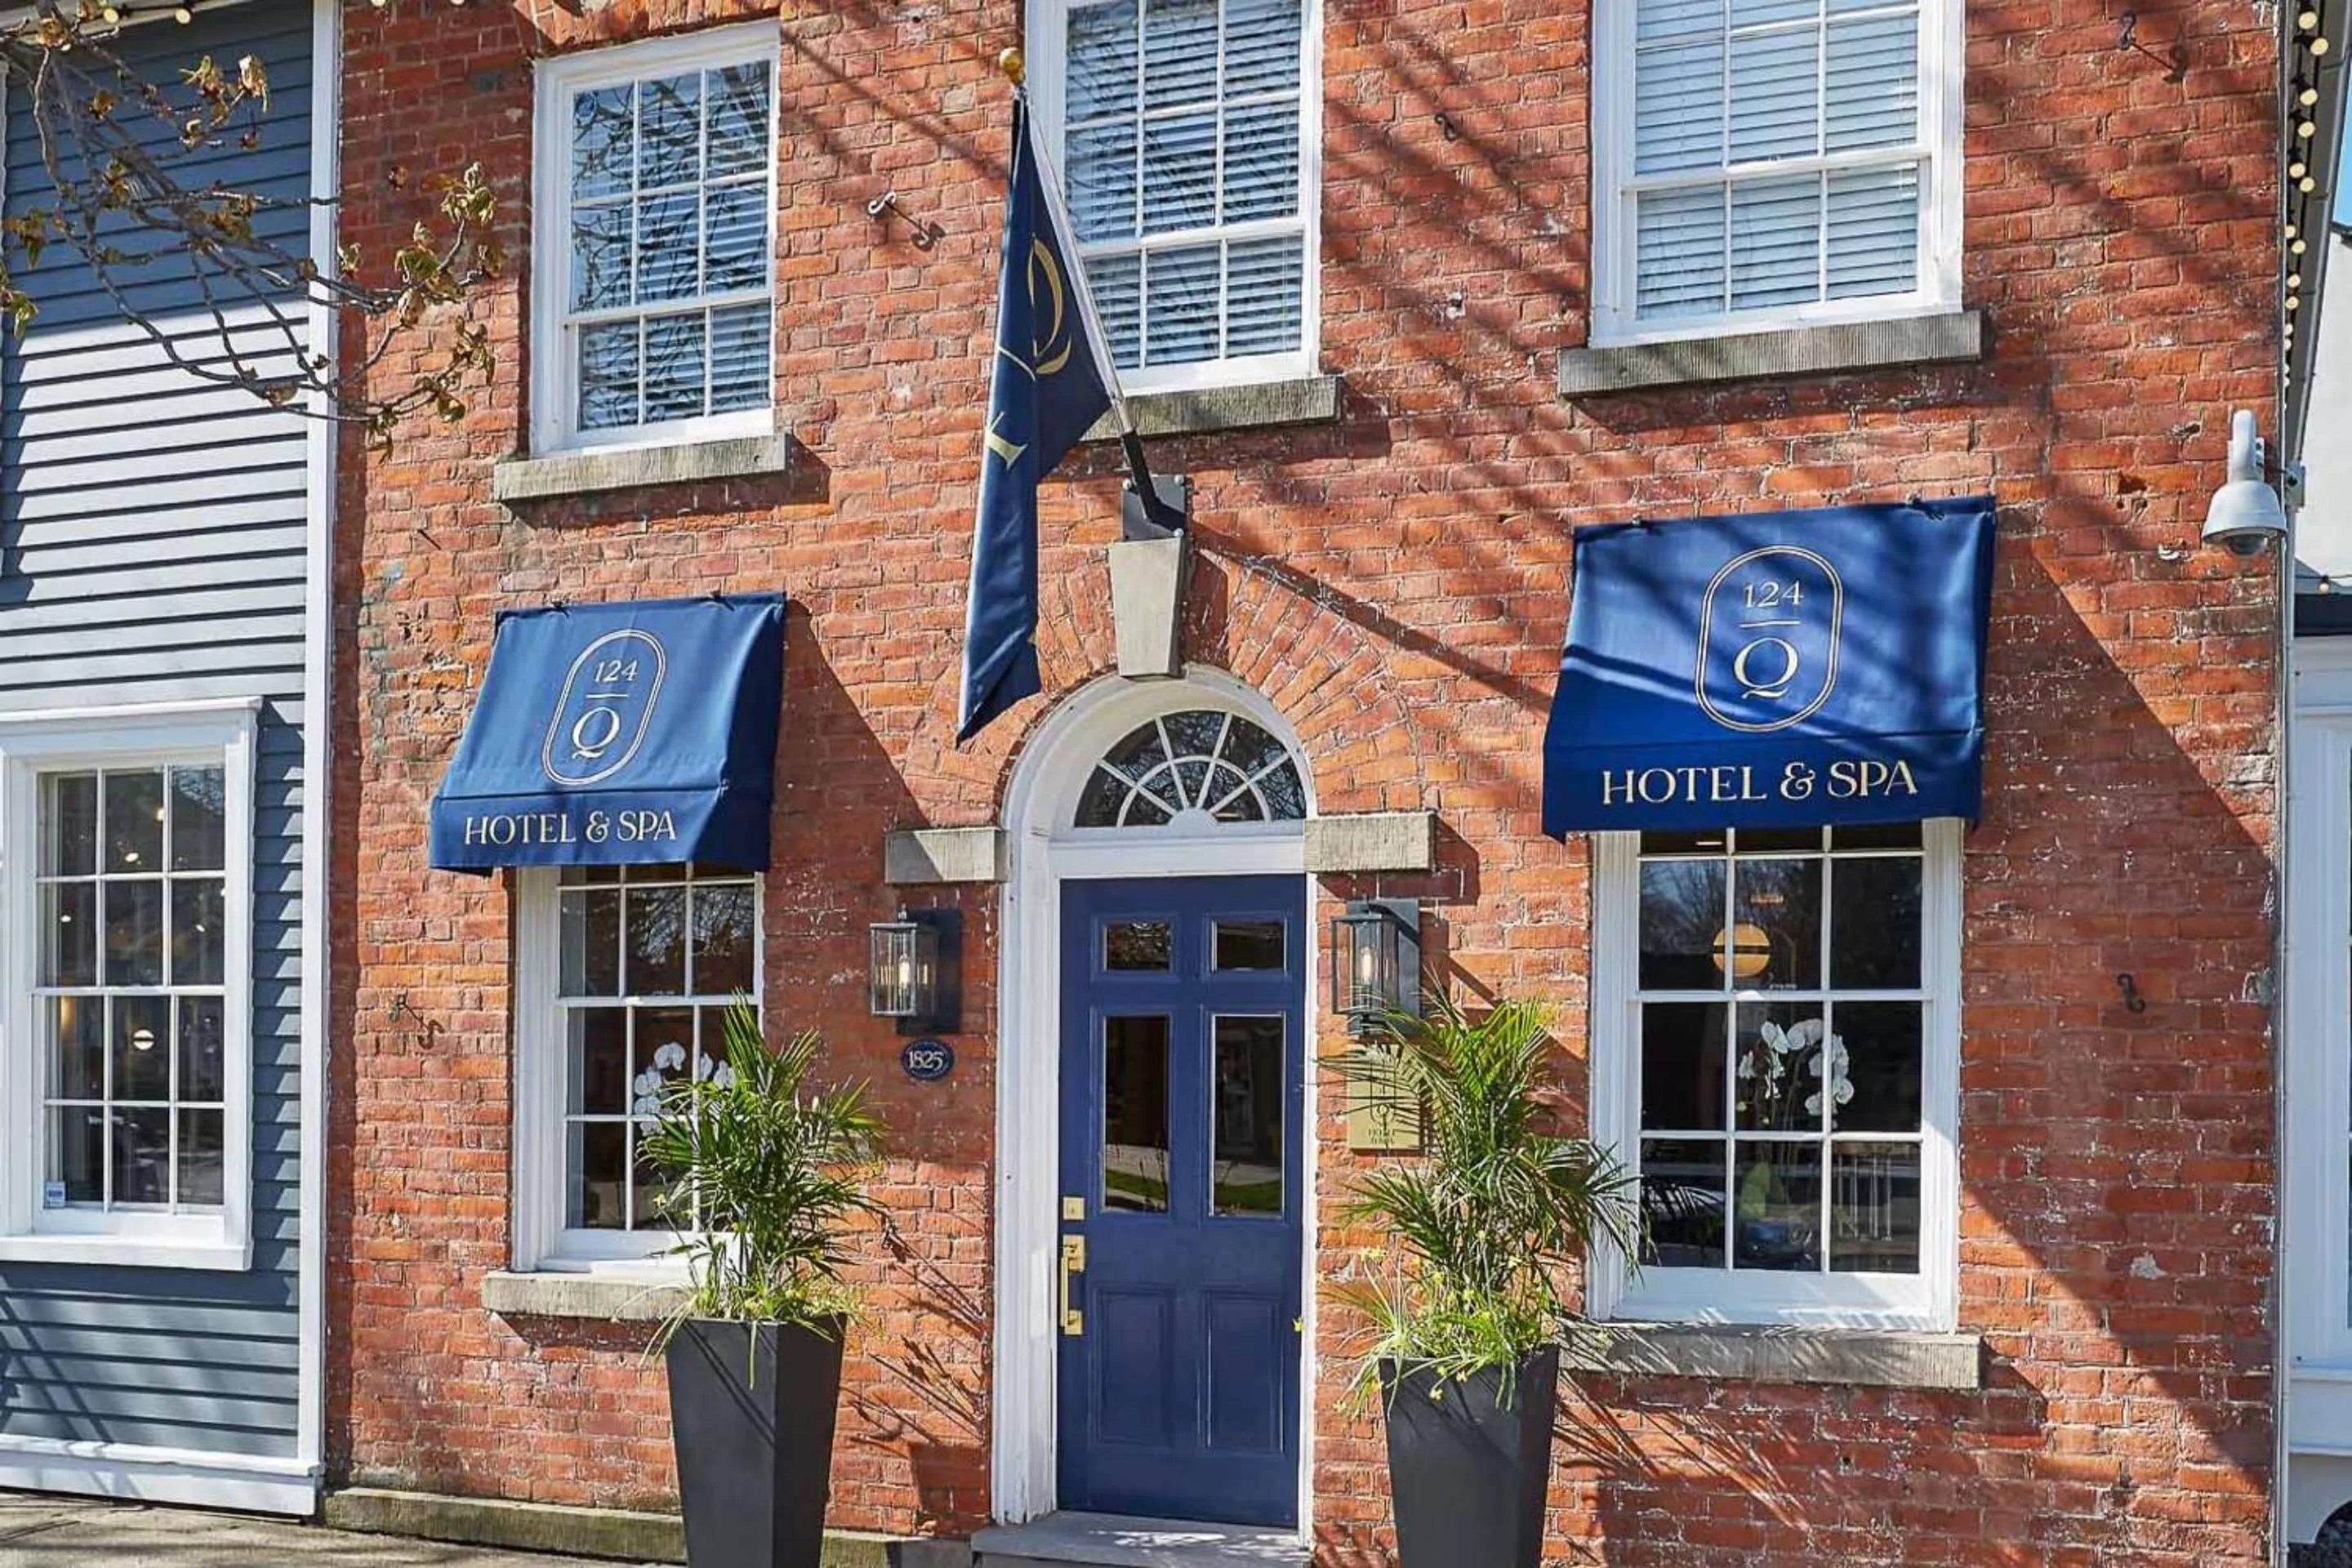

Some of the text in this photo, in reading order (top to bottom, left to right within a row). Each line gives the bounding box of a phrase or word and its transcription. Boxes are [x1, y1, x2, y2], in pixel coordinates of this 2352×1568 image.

[1744, 581, 1803, 608] 124
[595, 660, 638, 683] 124
[1734, 638, 1798, 699] Q
[572, 707, 621, 759] Q
[1603, 760, 1918, 804] HOTEL & SPA
[465, 810, 677, 844] HOTEL & SPA
[909, 1050, 944, 1071] 1825
